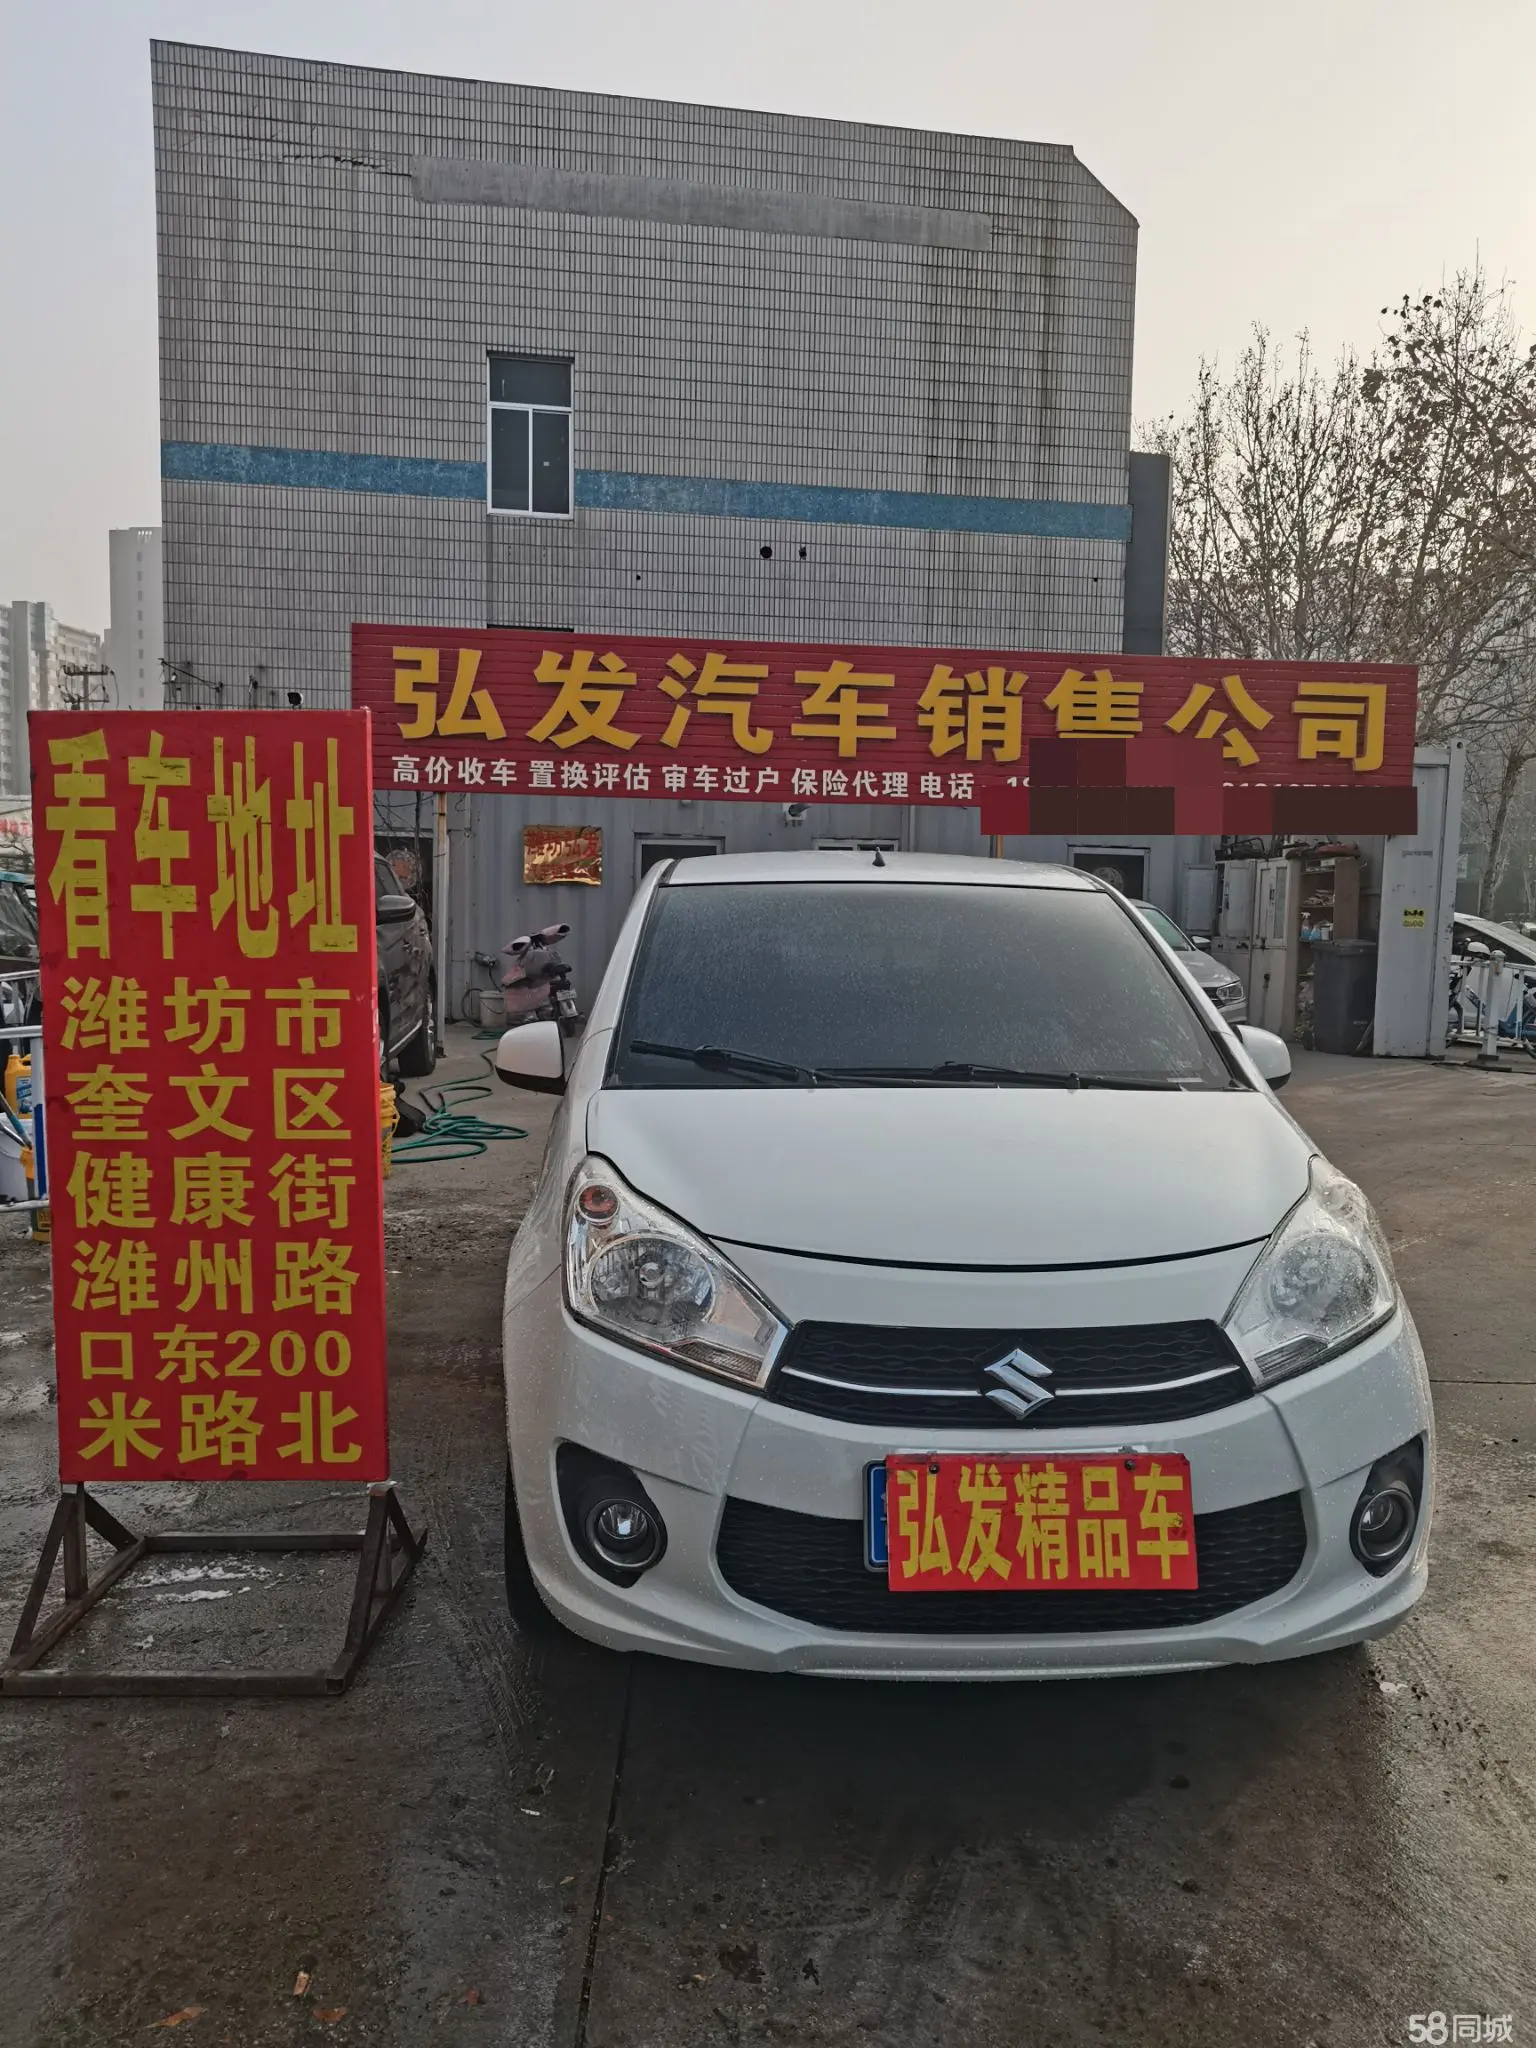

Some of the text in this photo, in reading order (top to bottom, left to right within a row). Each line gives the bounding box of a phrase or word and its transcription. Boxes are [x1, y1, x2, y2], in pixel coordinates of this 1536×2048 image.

[392, 647, 1387, 772] 弘发汽车销售公司
[392, 755, 974, 800] 高价收车 置换评估 审车过户 保险代理 电话
[46, 729, 357, 959] 看车地址
[60, 975, 350, 1054] 潍坊市
[65, 1063, 352, 1142] 奎文区
[66, 1151, 356, 1229] 健康街
[71, 1238, 360, 1316] 潍州路
[78, 1390, 362, 1467] 米路北
[897, 1462, 1189, 1582] 弘发精品车
